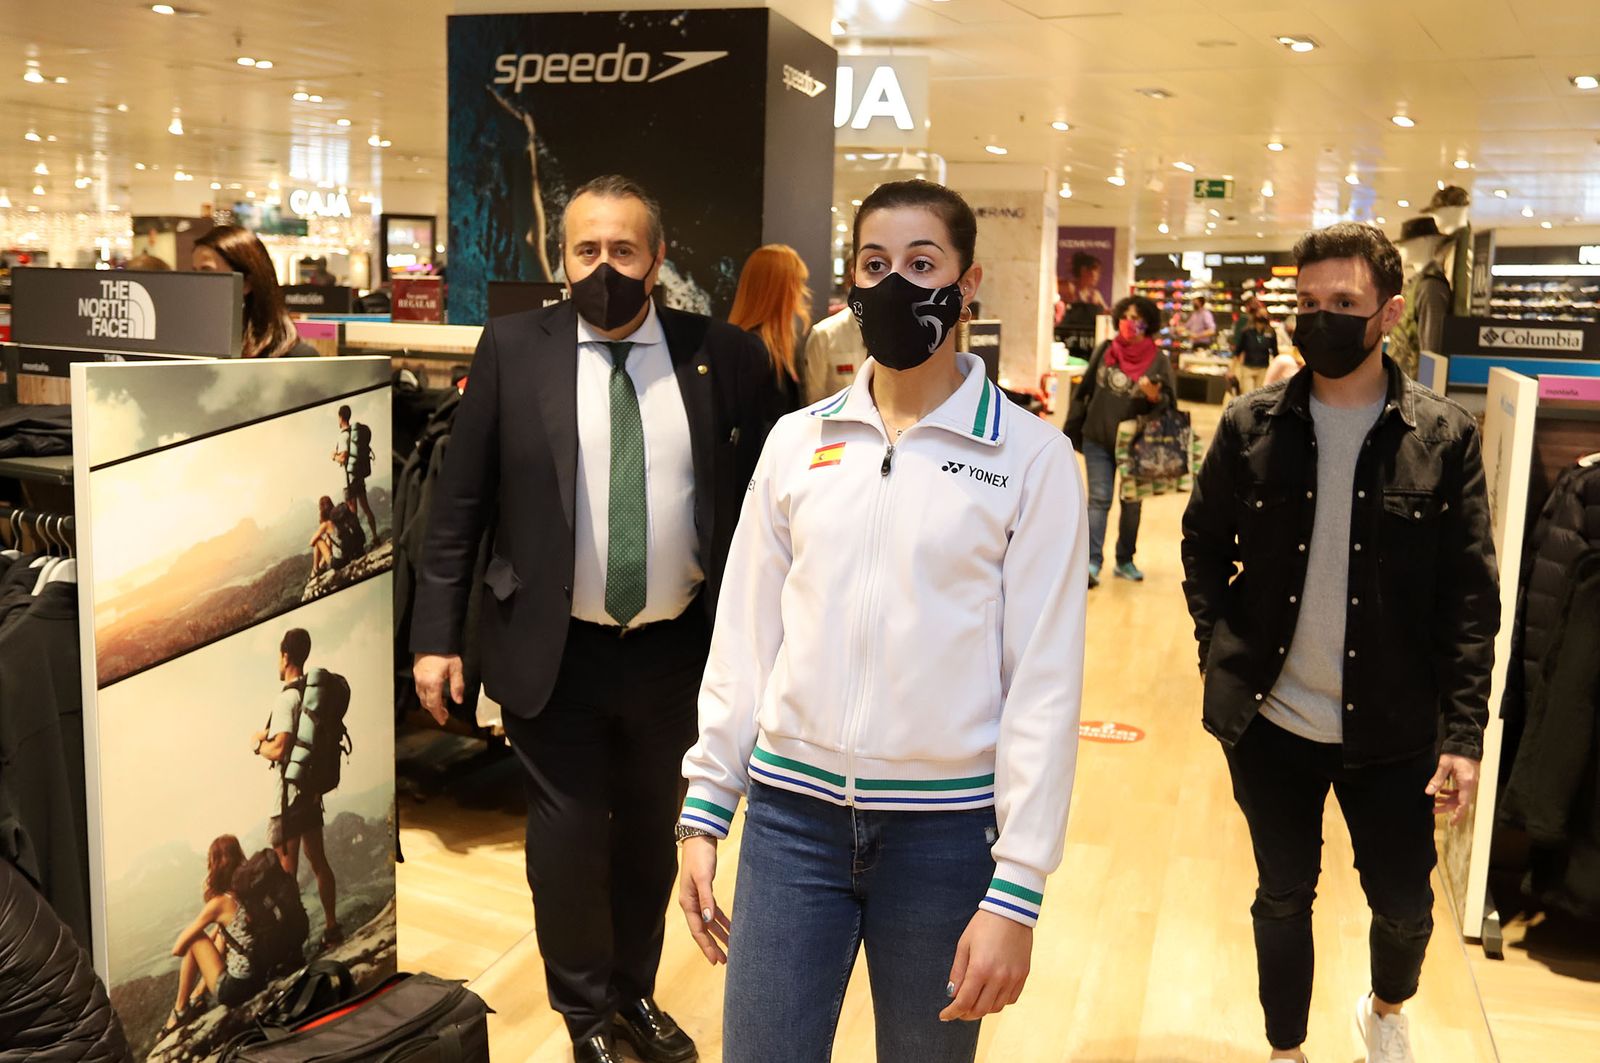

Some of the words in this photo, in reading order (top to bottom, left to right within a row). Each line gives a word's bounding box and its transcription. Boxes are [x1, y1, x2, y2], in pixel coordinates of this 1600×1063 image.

[494, 43, 651, 93] speedo
[289, 189, 352, 218] CAJA
[100, 280, 130, 300] THE
[78, 298, 129, 319] NORTH
[91, 318, 130, 338] FACE
[1501, 329, 1581, 348] Columbia
[968, 465, 1009, 489] YONEX
